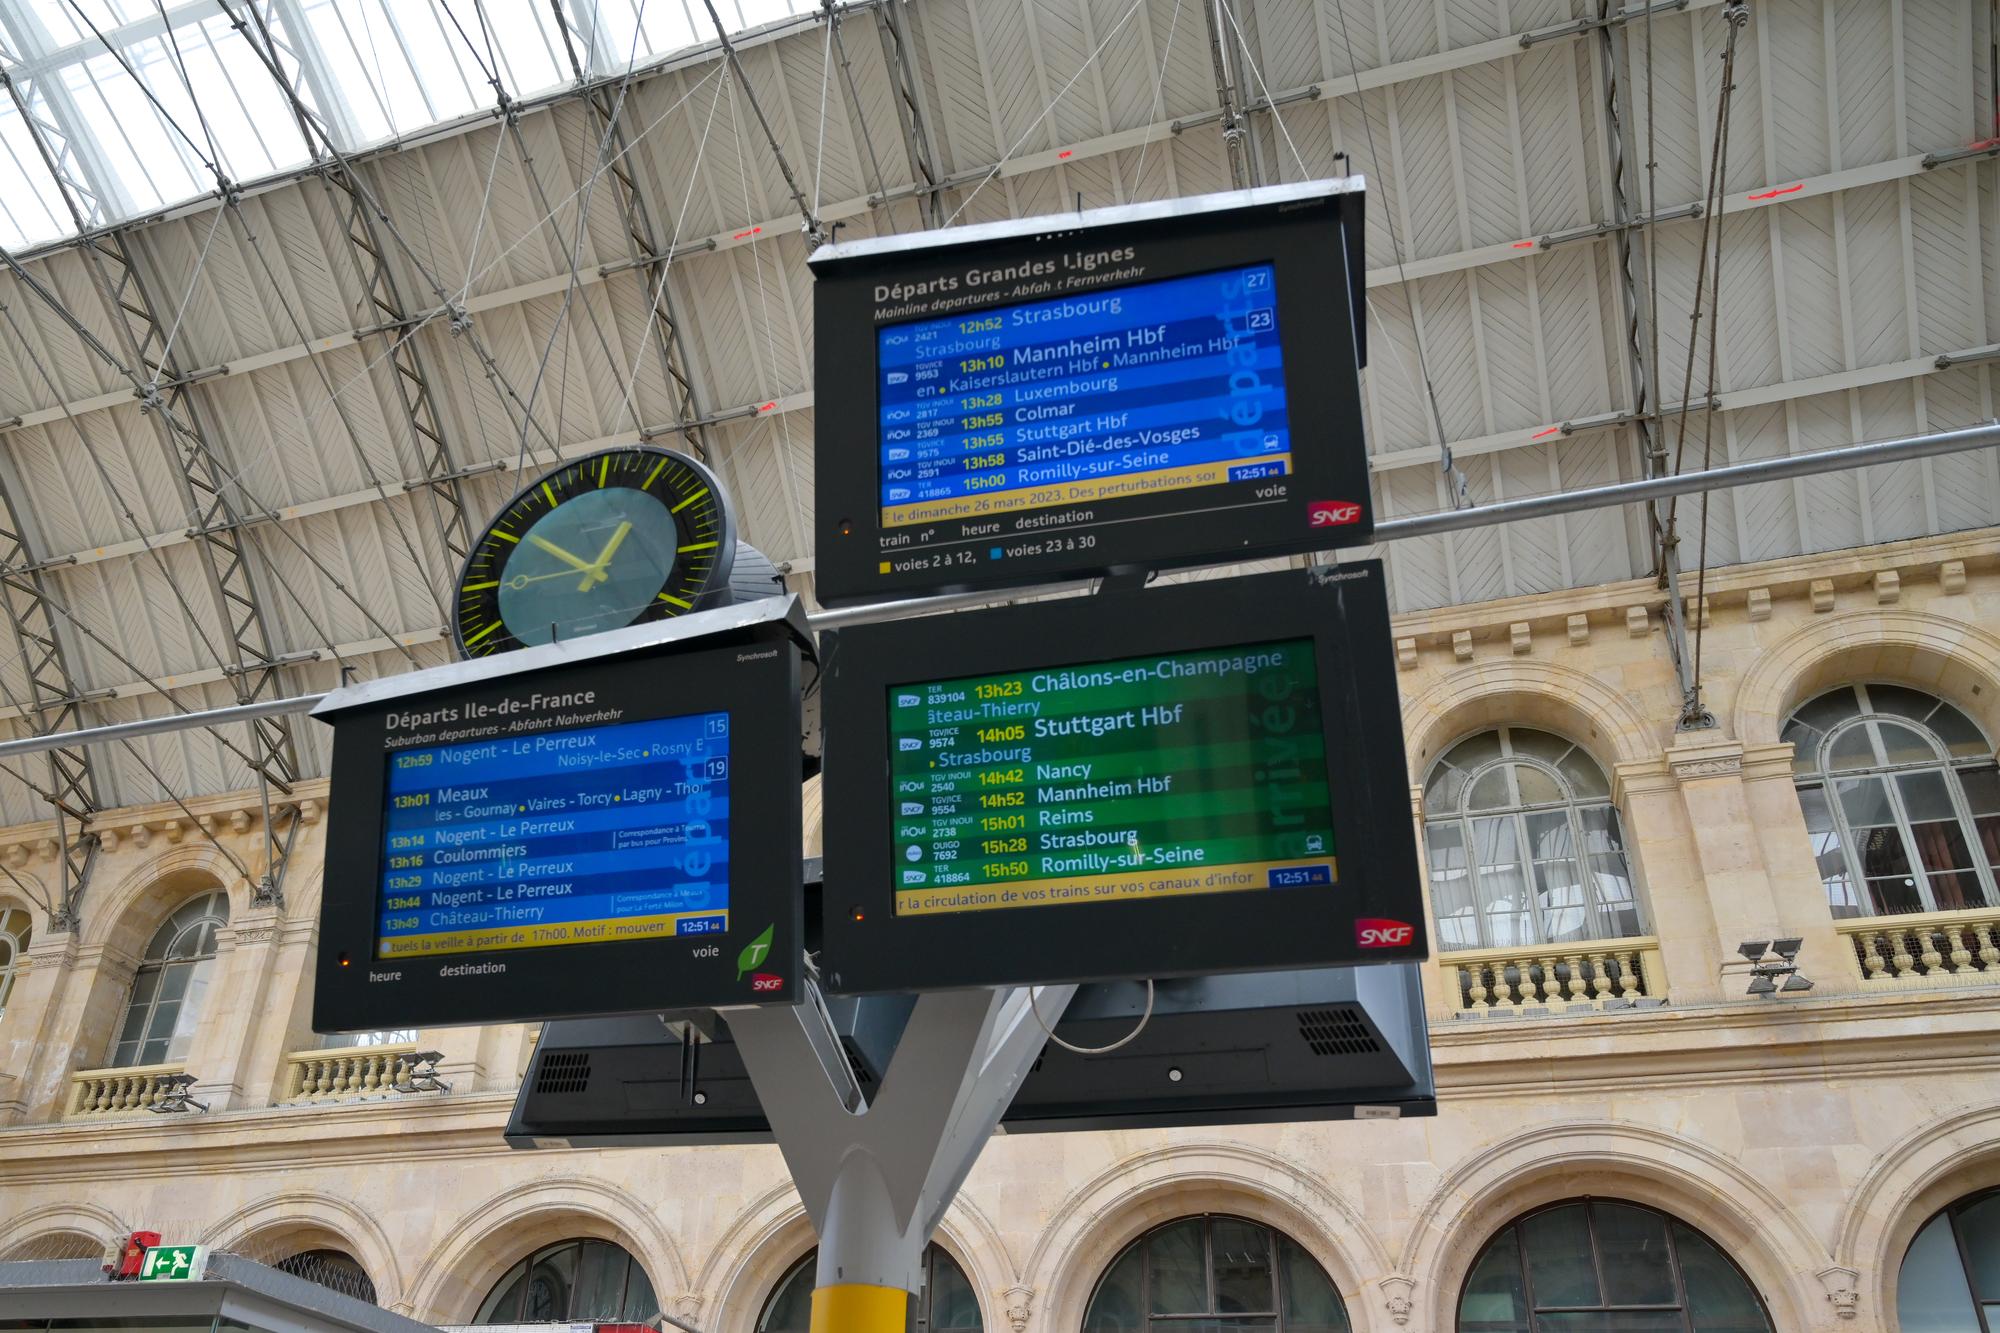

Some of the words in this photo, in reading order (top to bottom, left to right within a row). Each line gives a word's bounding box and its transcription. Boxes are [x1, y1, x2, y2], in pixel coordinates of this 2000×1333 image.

[874, 276, 959, 302] Départs
[966, 260, 1056, 287] Grandes
[1063, 246, 1135, 271] Lignes
[1247, 272, 1266, 288] 27
[875, 303, 927, 320] Mainline
[931, 289, 1000, 311] departures
[1066, 265, 1145, 288] Fernverkehr
[1012, 296, 1122, 327] Strasbourg
[1250, 311, 1271, 329] 23
[959, 316, 1003, 335] 12h52
[916, 336, 1001, 360] Strasbourg
[1013, 336, 1120, 365] Mannheim
[1127, 325, 1166, 347] Hbf
[949, 366, 1063, 392] Kaiserslautern
[1068, 356, 1099, 374] Hbf
[1113, 342, 1203, 367] Mannheim
[1209, 336, 1240, 353] Hbf
[959, 354, 1005, 374] 13h10
[1015, 377, 1119, 403] Luxembourg
[961, 393, 1003, 411] 13h28
[1015, 403, 1076, 422] Colmar
[961, 413, 1003, 431] 13h55
[1016, 421, 1092, 443] Stuttgart
[1097, 412, 1129, 431] Hbf
[917, 428, 939, 440] 2369
[963, 433, 1005, 451] 13h55
[1017, 426, 1200, 463] Saint-Dié-des-Vosges
[963, 453, 1005, 471] 13h58
[1018, 452, 1169, 483] Romilly-sur-Seine
[918, 468, 939, 480] 2591
[964, 474, 1006, 491] 15h00
[1235, 466, 1267, 481] 12:51
[908, 504, 970, 521] dimanche
[974, 500, 990, 512] 26
[993, 495, 1026, 509] mars
[1069, 486, 1094, 499] Des
[1098, 475, 1192, 497] perturbations
[1255, 484, 1288, 498] voie
[1015, 510, 1094, 530] destination
[1311, 506, 1360, 526] SNCF
[961, 522, 1000, 537] heure
[880, 533, 911, 548] train
[1006, 543, 1043, 558] voies
[1045, 539, 1063, 553] 23
[1066, 537, 1075, 550] à
[1078, 535, 1097, 550] 30
[894, 558, 930, 573] voies
[932, 556, 941, 567] 2
[944, 554, 953, 566] à
[1031, 652, 1282, 693] Châlons-en-Champagne
[928, 685, 943, 693] TER
[975, 681, 1023, 699] 13h23
[928, 692, 966, 705] 839104
[385, 707, 459, 730] Départs
[464, 691, 595, 720] Ile-de-France
[384, 730, 436, 749] Suburban
[439, 725, 499, 743] departures
[508, 716, 552, 732] Abfahrt
[555, 708, 623, 727] Nahverkehr
[708, 720, 726, 734] 15
[1034, 711, 1135, 738] Stuttgart
[1142, 704, 1183, 726] Hbf
[929, 736, 955, 749] 9574
[977, 725, 1025, 743] 14h05
[440, 744, 497, 765] Nogent
[512, 741, 531, 756] Le
[536, 734, 596, 752] Perreux
[558, 747, 641, 768] Noisy-le-Sec
[651, 741, 692, 758] Rosny
[939, 747, 1032, 769] Strasbourg
[397, 754, 433, 769] 12h59
[707, 761, 726, 776] 19
[931, 773, 948, 782] TGV
[949, 771, 972, 780] INOUI
[979, 768, 1024, 786] 14h42
[1037, 764, 1092, 781] Nancy
[437, 787, 489, 804] Meaux
[930, 782, 955, 793] 2540
[1038, 781, 1132, 803] Mannheim
[1137, 775, 1172, 794] Hbf
[393, 794, 430, 809] 13h01
[464, 802, 518, 820] Gournay
[527, 797, 566, 812] Vaires
[577, 791, 613, 808] Torcy
[623, 786, 663, 804] Lagny
[979, 791, 1024, 808] 14h52
[932, 804, 956, 815] 9554
[1039, 809, 1094, 827] Reims
[932, 818, 948, 827] TGV
[949, 816, 973, 825] INOUI
[980, 815, 1026, 832] 15h01
[435, 827, 487, 847] Nogent
[500, 824, 517, 838] Le
[521, 819, 575, 836] Perreux
[932, 827, 957, 838] 2738
[1040, 829, 1138, 850] Strasbourg
[391, 835, 425, 850] 13h14
[932, 840, 960, 850] OUIGO
[981, 838, 1027, 855] 15h28
[389, 855, 423, 870] 13h16
[433, 844, 528, 865] Coulommiers
[933, 850, 957, 861] 7692
[1041, 847, 1205, 874] Romilly-sur-Seine
[432, 868, 485, 887] Nogent
[500, 866, 515, 879] Le
[519, 861, 574, 877] Perreux
[933, 864, 950, 873] TER
[982, 861, 1028, 878] 15h50
[388, 875, 422, 890] 13h29
[934, 873, 970, 884] 418864
[1275, 871, 1310, 885] 12:51
[386, 895, 421, 910] 13h44
[431, 888, 484, 908] Nogent
[497, 886, 514, 900] Le
[518, 882, 573, 898] Perreux
[907, 897, 920, 910] la
[923, 891, 997, 909] circulation
[1001, 889, 1018, 902] de
[1022, 888, 1046, 900] vos
[1050, 883, 1090, 900] trains
[1094, 884, 1115, 896] sur
[1120, 880, 1145, 893] vos
[1149, 877, 1200, 892] canaux
[385, 916, 419, 931] 13h49
[430, 905, 545, 926] Château-Thierry
[682, 921, 709, 932] 12:51
[422, 940, 431, 950] la
[434, 936, 465, 949] veille
[467, 936, 474, 946] à
[477, 931, 508, 947] partir
[514, 933, 525, 943] de
[573, 923, 606, 938] Motif
[1359, 927, 1411, 945] SNCF
[692, 945, 720, 959] voie
[369, 971, 402, 983] heure
[440, 962, 506, 978] destination
[754, 979, 781, 991] SNCF
